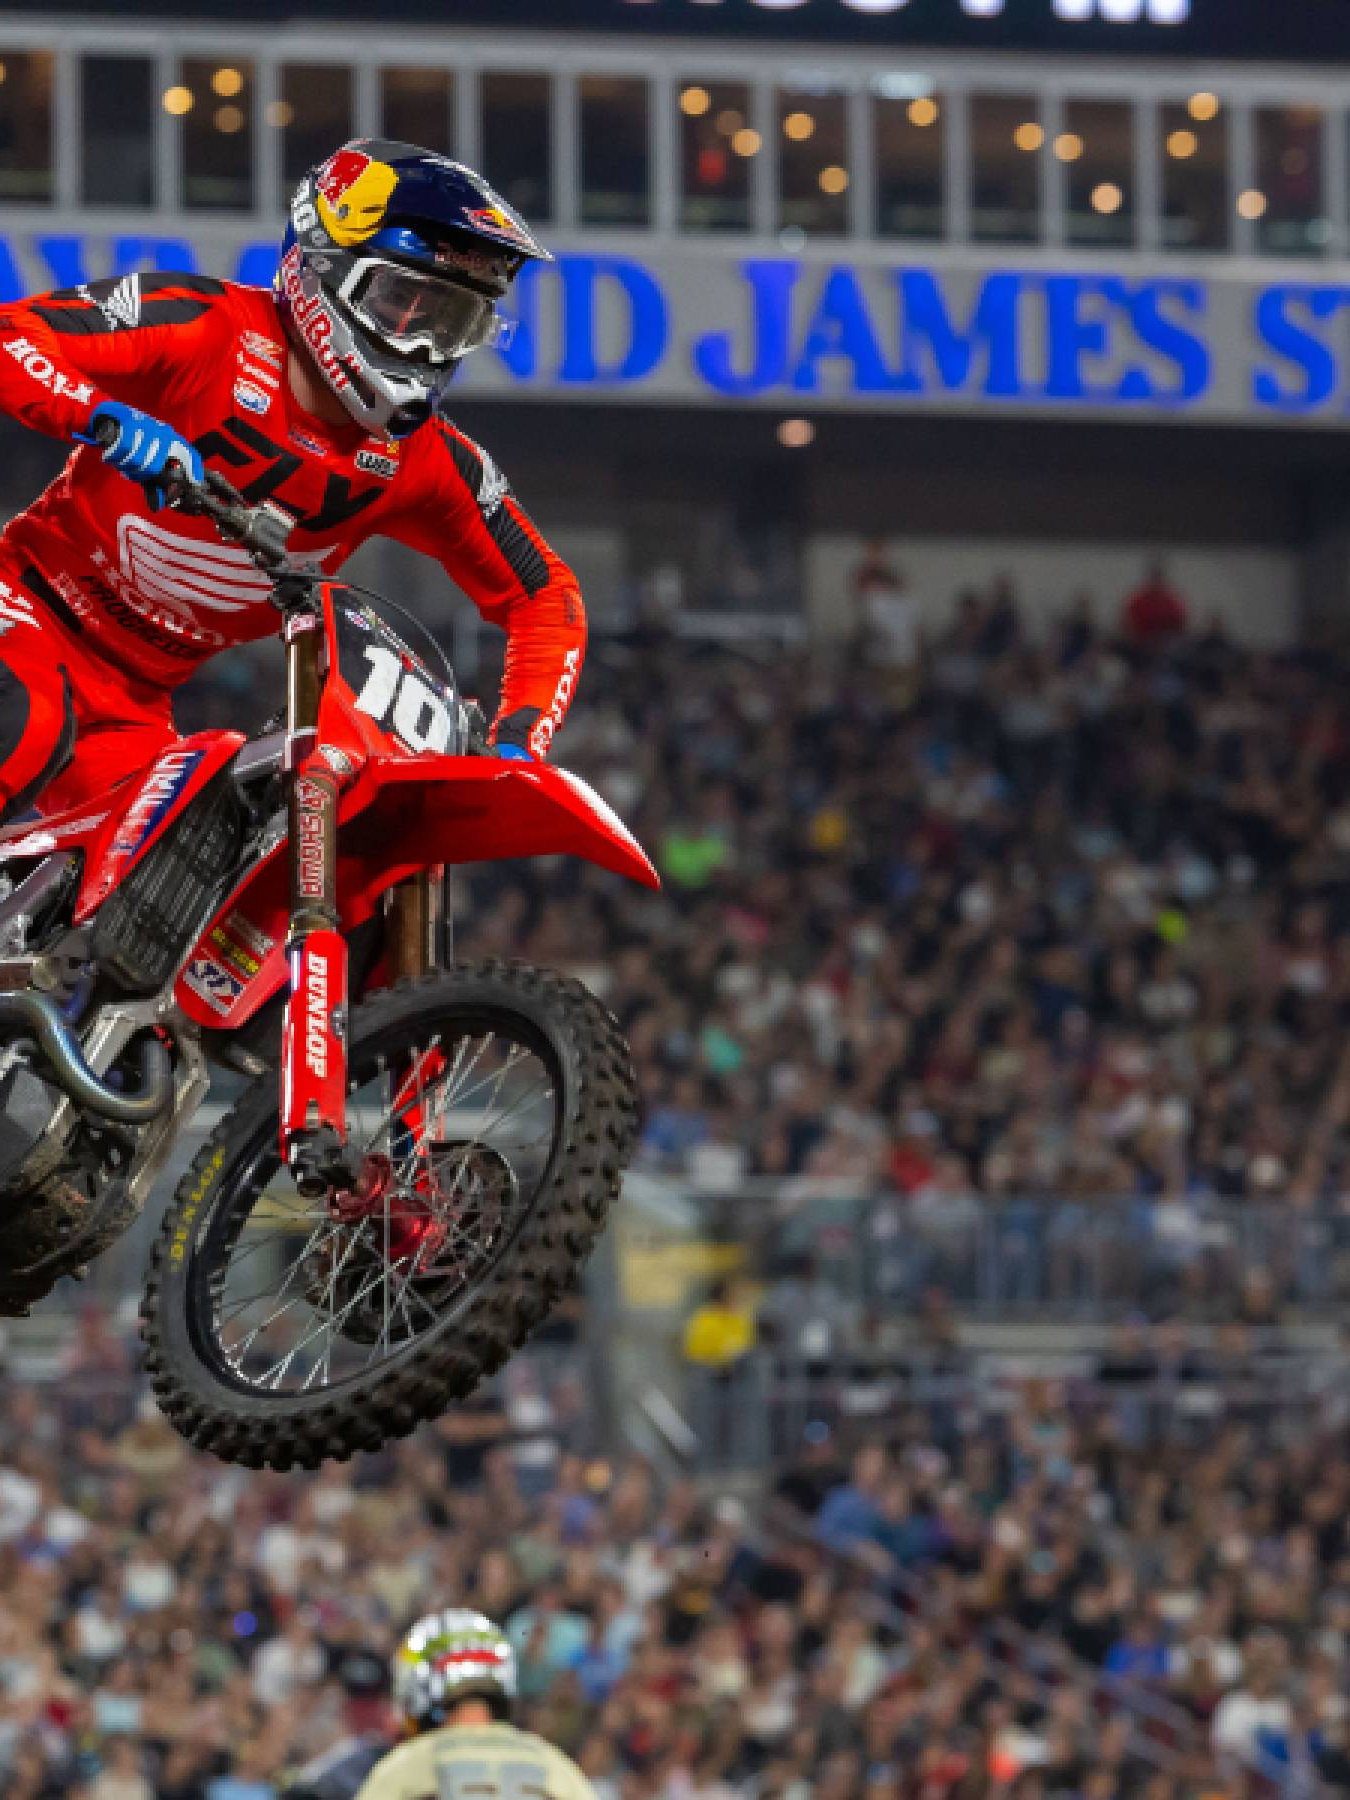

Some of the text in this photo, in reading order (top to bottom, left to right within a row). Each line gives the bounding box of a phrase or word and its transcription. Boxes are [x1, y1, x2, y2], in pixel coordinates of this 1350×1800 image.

[304, 312, 363, 391] Bull
[695, 259, 1212, 407] JAMES
[1254, 283, 1350, 413] S
[193, 416, 386, 532] FLY
[354, 644, 452, 753] 10
[299, 812, 326, 898] SHOWA
[307, 951, 328, 1078] DUNLOP
[170, 1145, 227, 1263] DUNLOP
